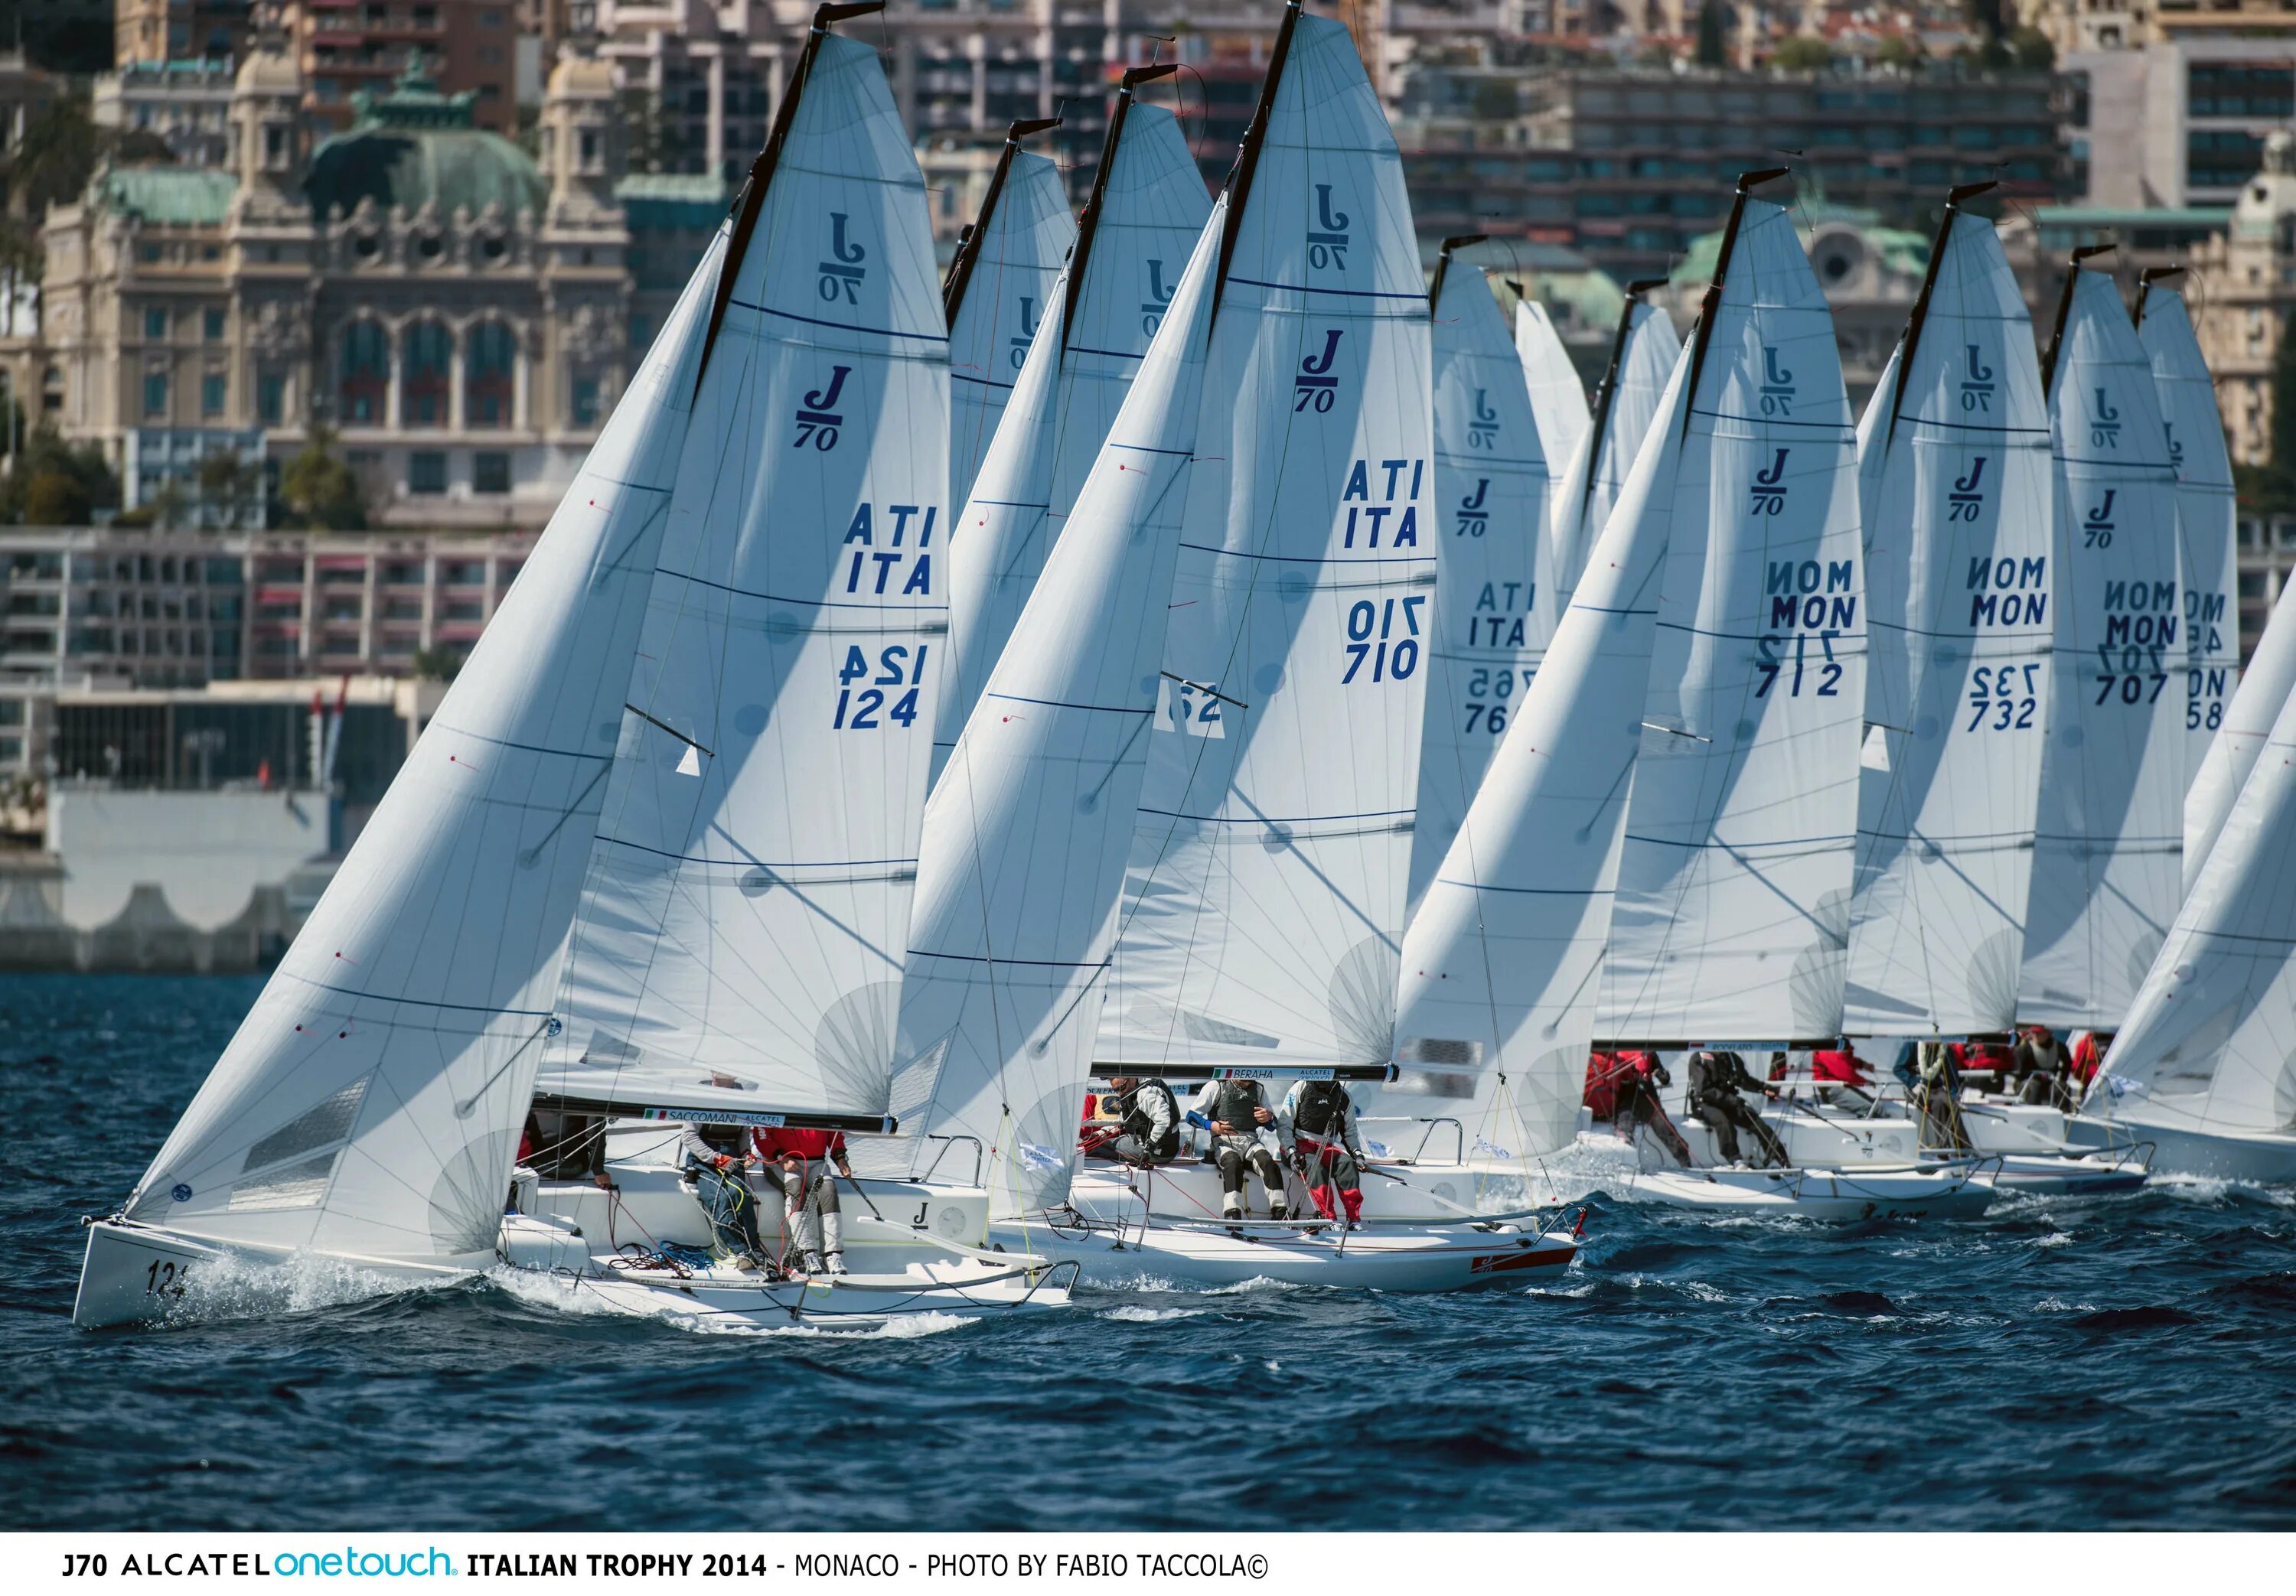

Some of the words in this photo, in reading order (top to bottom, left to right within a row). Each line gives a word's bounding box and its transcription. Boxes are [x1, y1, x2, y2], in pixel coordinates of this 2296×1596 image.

[1302, 330, 1344, 374] J
[804, 366, 852, 411] J
[1295, 387, 1335, 413] 70
[794, 424, 838, 451] 70
[1757, 448, 1789, 485] J
[1955, 457, 1987, 493] J
[1463, 479, 1489, 510] J
[1751, 495, 1784, 516] 70
[2089, 489, 2116, 521] J
[1345, 506, 1417, 548] ITA
[1949, 501, 1979, 523] 70
[1457, 520, 1486, 538] 70
[2083, 530, 2112, 549] 70
[846, 552, 931, 594] ITA
[1771, 595, 1856, 629] MON
[1969, 593, 2047, 627] MON
[1469, 617, 1525, 647] ITA
[2106, 614, 2177, 645] MON
[1342, 639, 1419, 684] 710
[1755, 663, 1842, 698] 712
[2095, 674, 2167, 706] 707
[833, 689, 918, 729] 124
[1465, 703, 1518, 734] 76
[1966, 698, 2036, 732] 732
[1234, 1070, 1274, 1079] BERAHA
[669, 1111, 736, 1124] SACCOMANI
[913, 1202, 928, 1223] J
